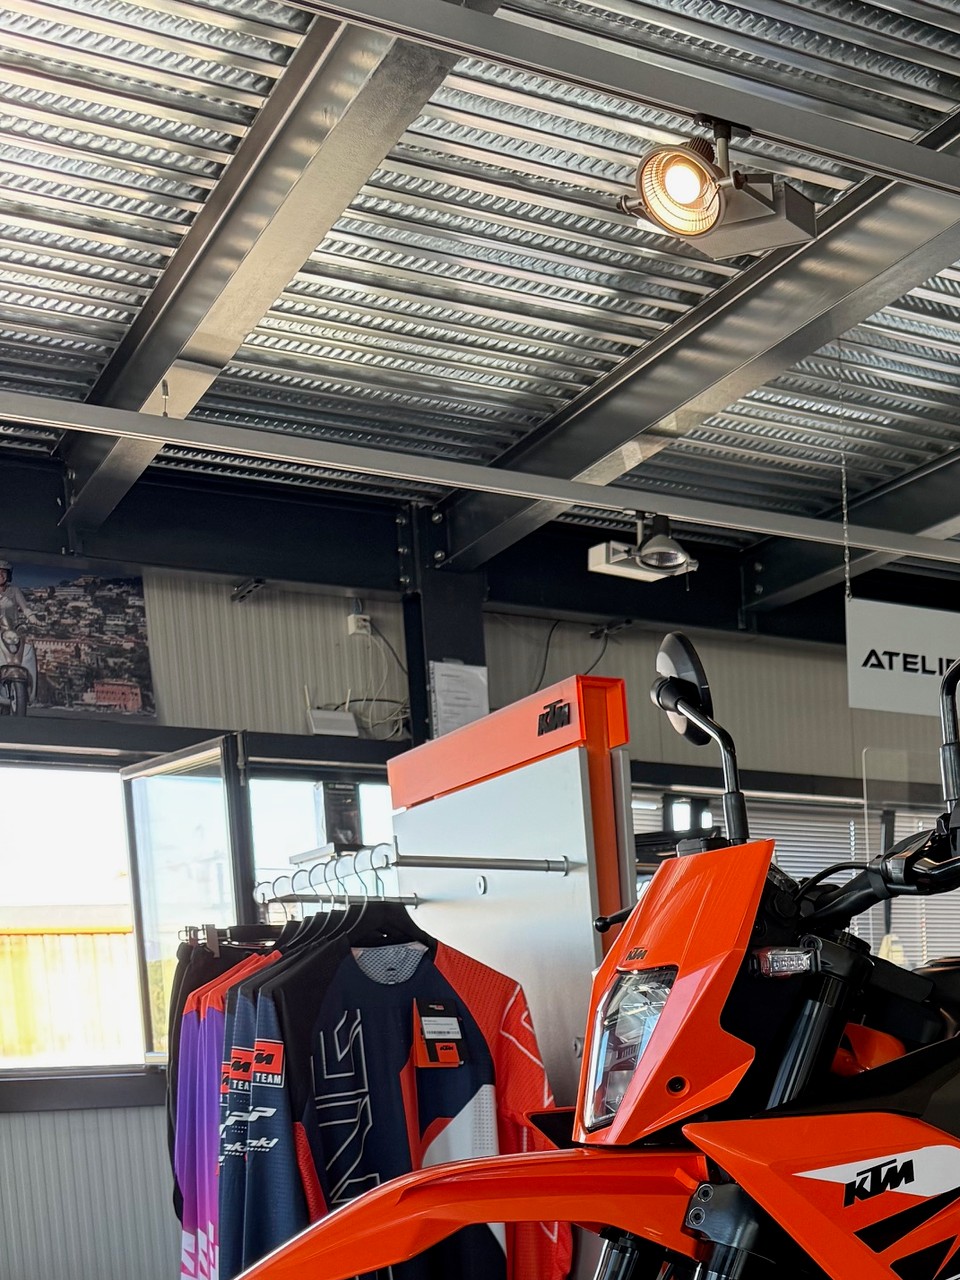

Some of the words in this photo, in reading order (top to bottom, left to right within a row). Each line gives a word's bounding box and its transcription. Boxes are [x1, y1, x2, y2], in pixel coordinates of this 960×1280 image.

[537, 699, 571, 737] KTM
[625, 946, 649, 961] KTM
[255, 1073, 282, 1084] TEAM
[843, 1158, 915, 1208] KTM
